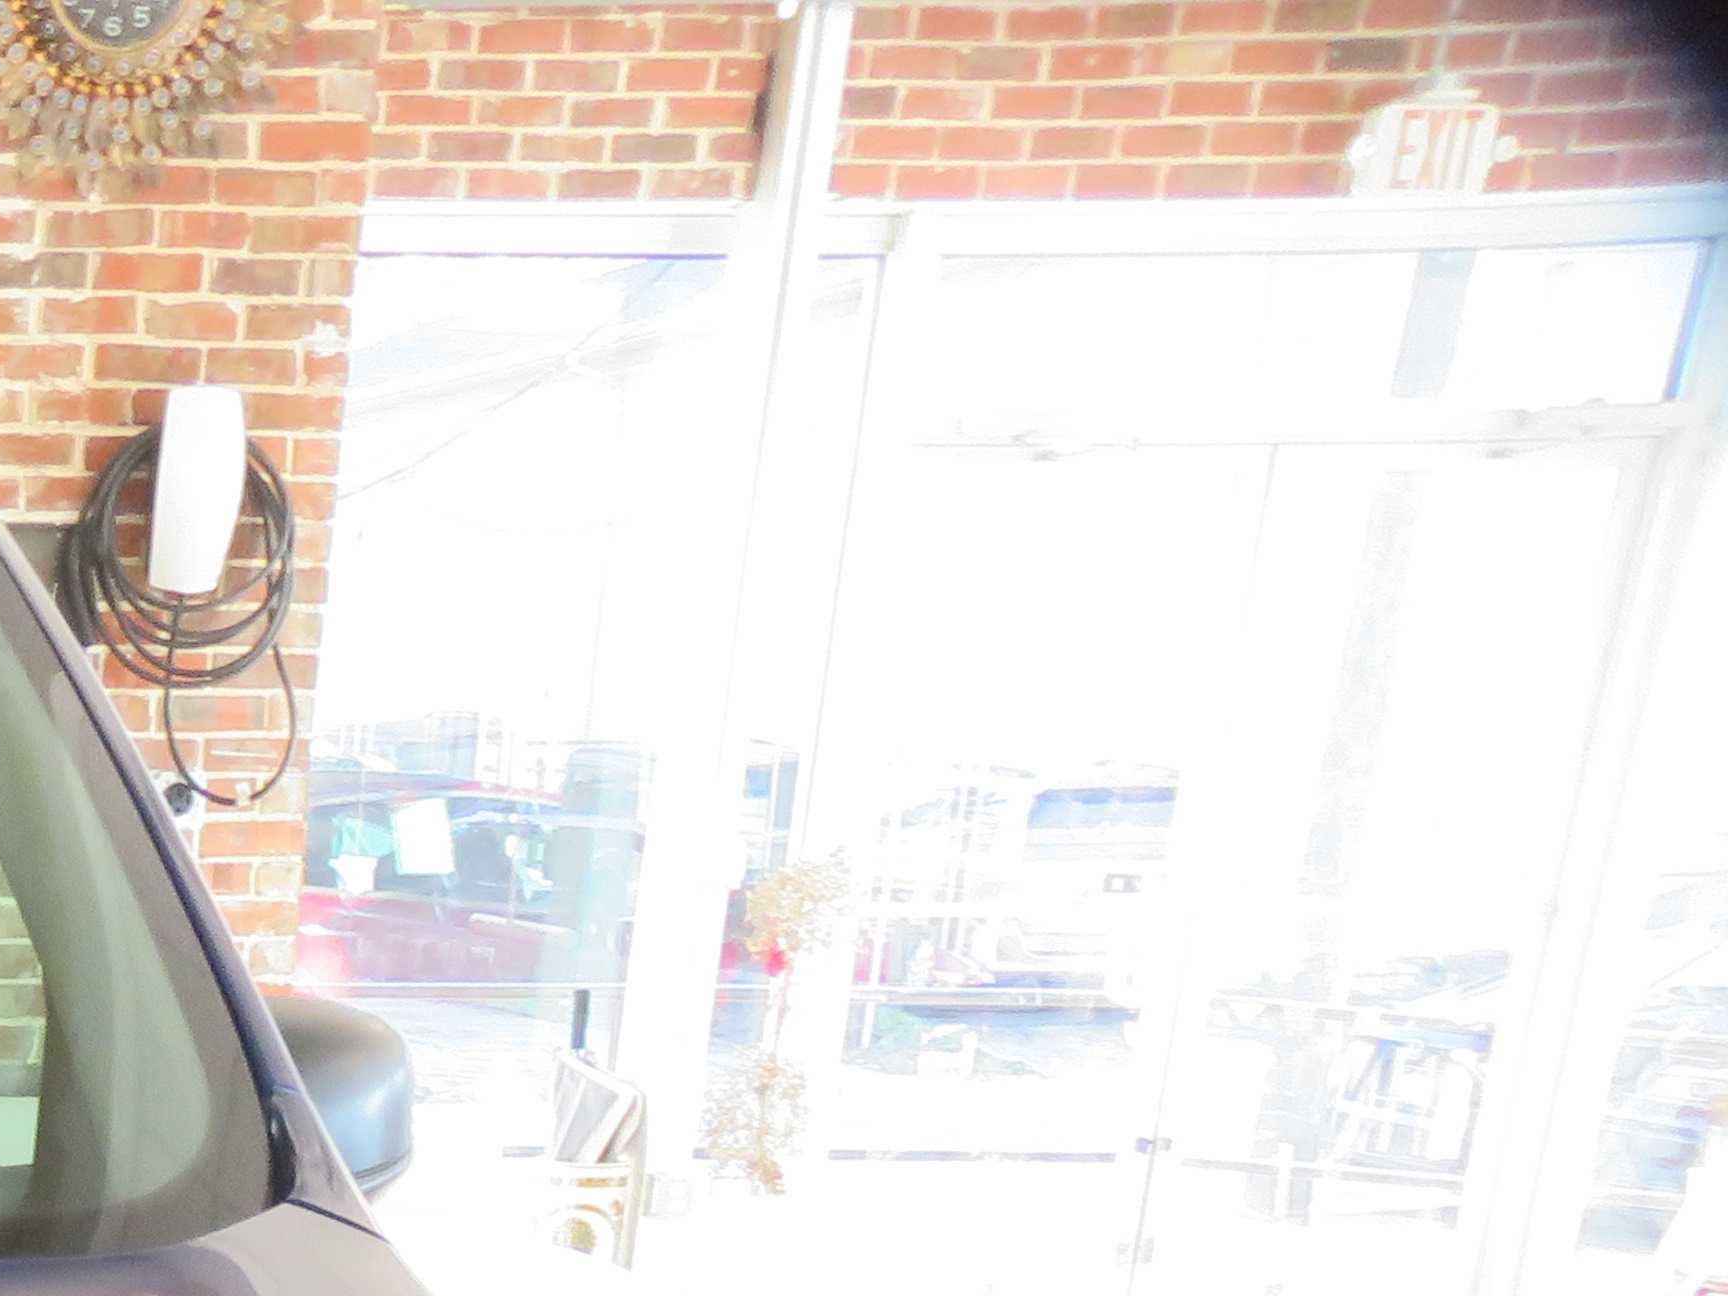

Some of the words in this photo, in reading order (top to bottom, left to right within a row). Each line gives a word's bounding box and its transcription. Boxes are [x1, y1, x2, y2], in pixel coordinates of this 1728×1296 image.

[78, 9, 96, 30] 7
[103, 16, 123, 36] 6
[133, 6, 151, 29] 5
